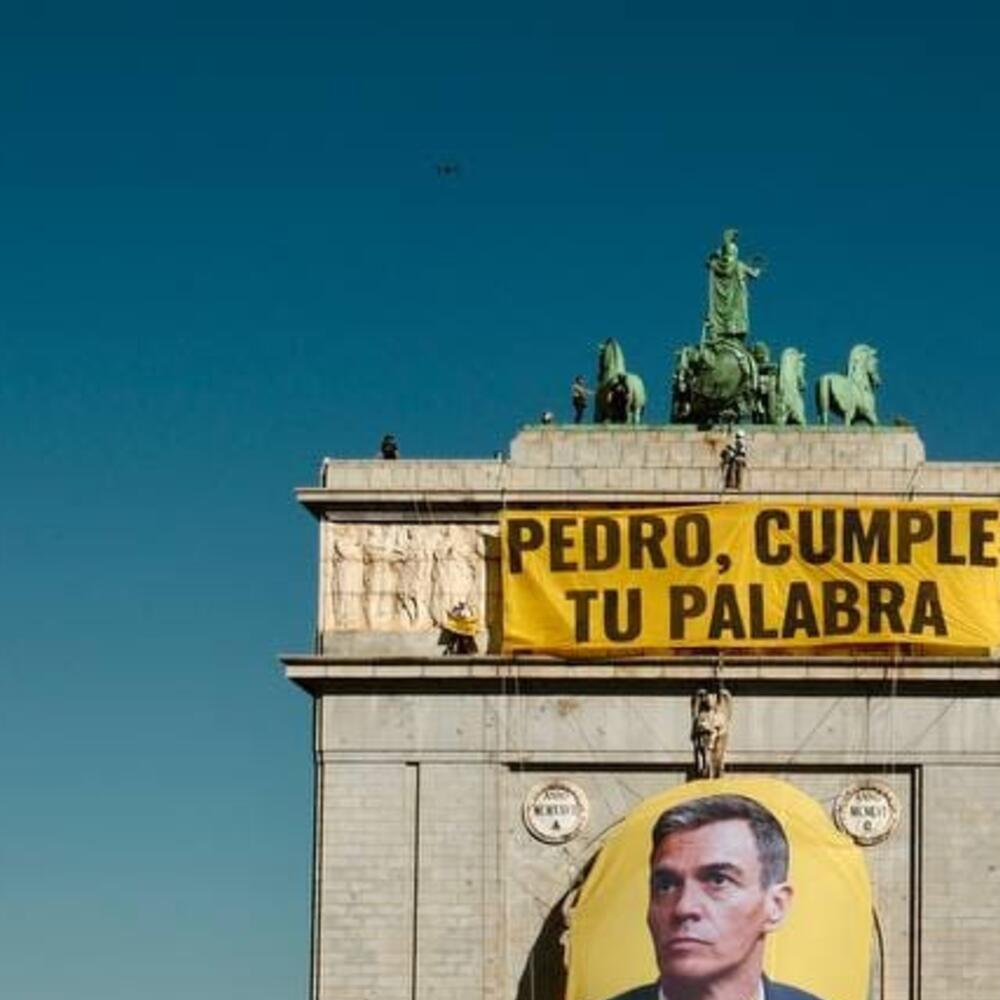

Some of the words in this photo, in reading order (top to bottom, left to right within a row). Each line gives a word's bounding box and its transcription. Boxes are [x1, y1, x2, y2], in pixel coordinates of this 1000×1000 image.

[507, 513, 731, 575] PEDRO,
[754, 508, 999, 568] CUMPLE
[566, 588, 642, 643] TU
[669, 580, 948, 641] PALABRA
